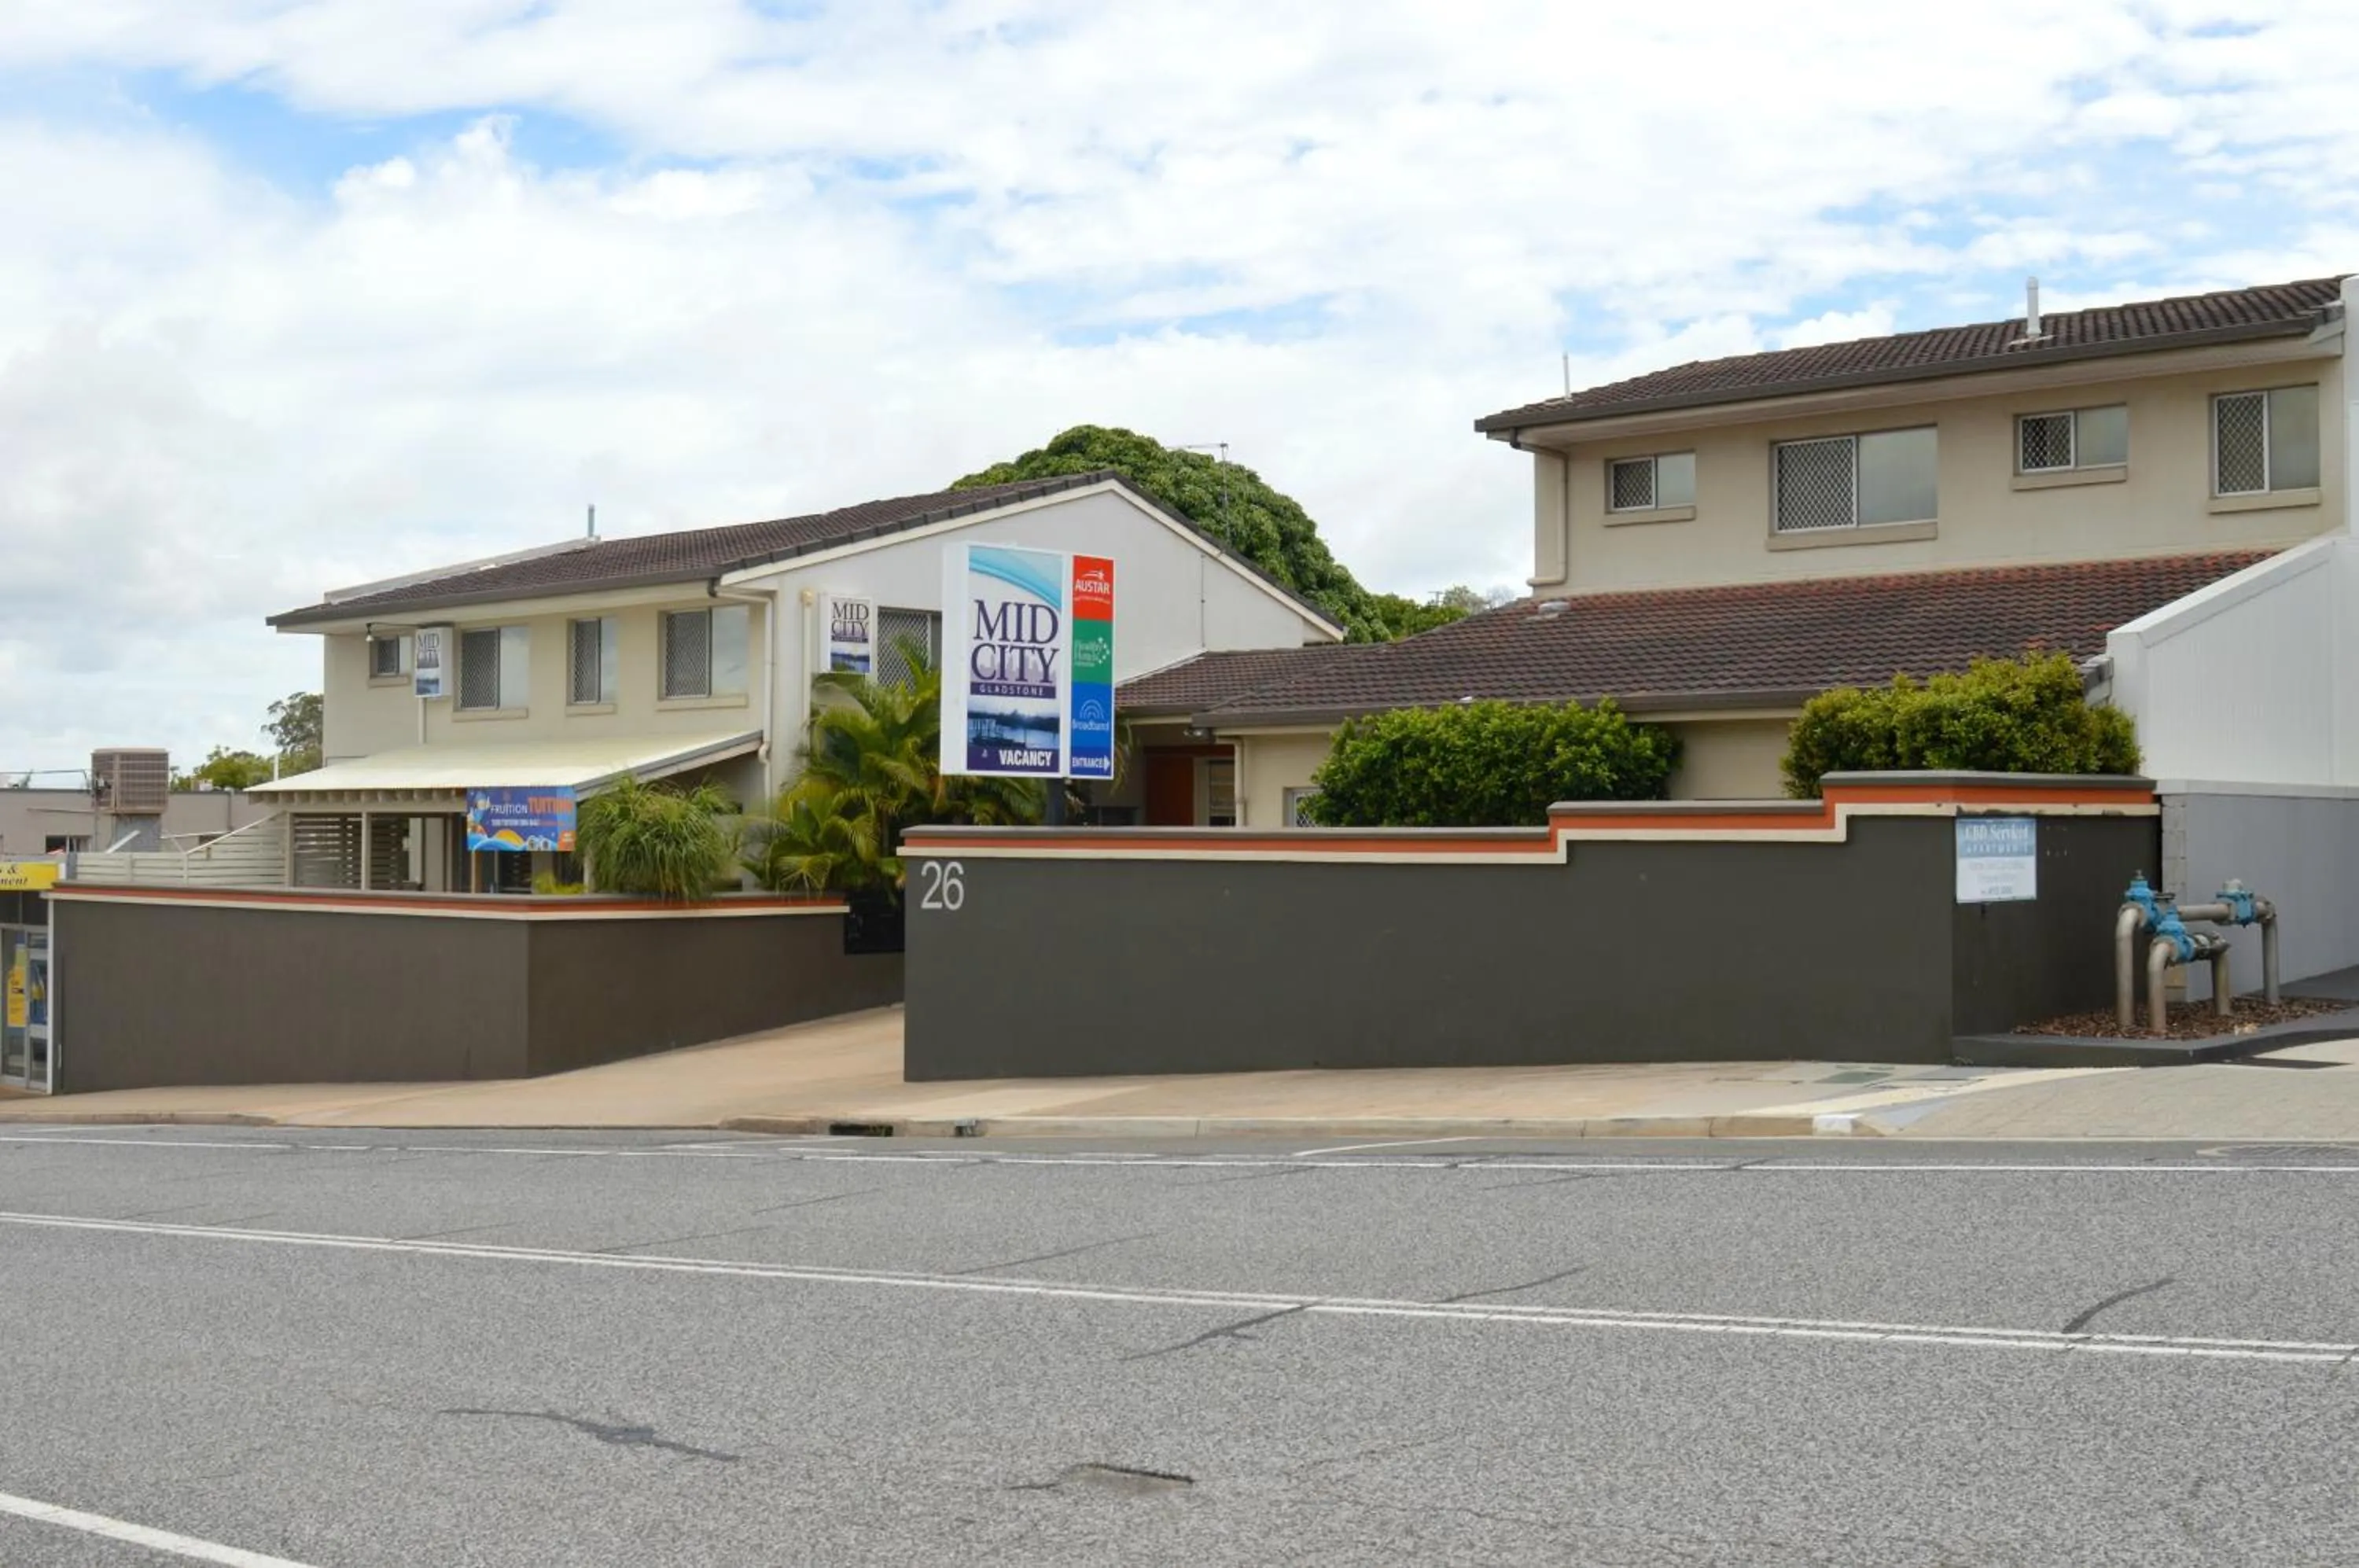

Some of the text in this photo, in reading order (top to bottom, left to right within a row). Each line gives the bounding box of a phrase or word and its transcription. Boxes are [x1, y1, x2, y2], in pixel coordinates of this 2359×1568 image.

[1074, 578, 1110, 594] AUSTAR
[832, 602, 869, 620] MID
[831, 620, 868, 637] CITY
[973, 599, 1059, 644] MID
[970, 642, 1059, 683] CITY
[979, 683, 1044, 696] GLADSTONE
[999, 749, 1052, 767] VACANCY
[920, 860, 965, 911] 26
